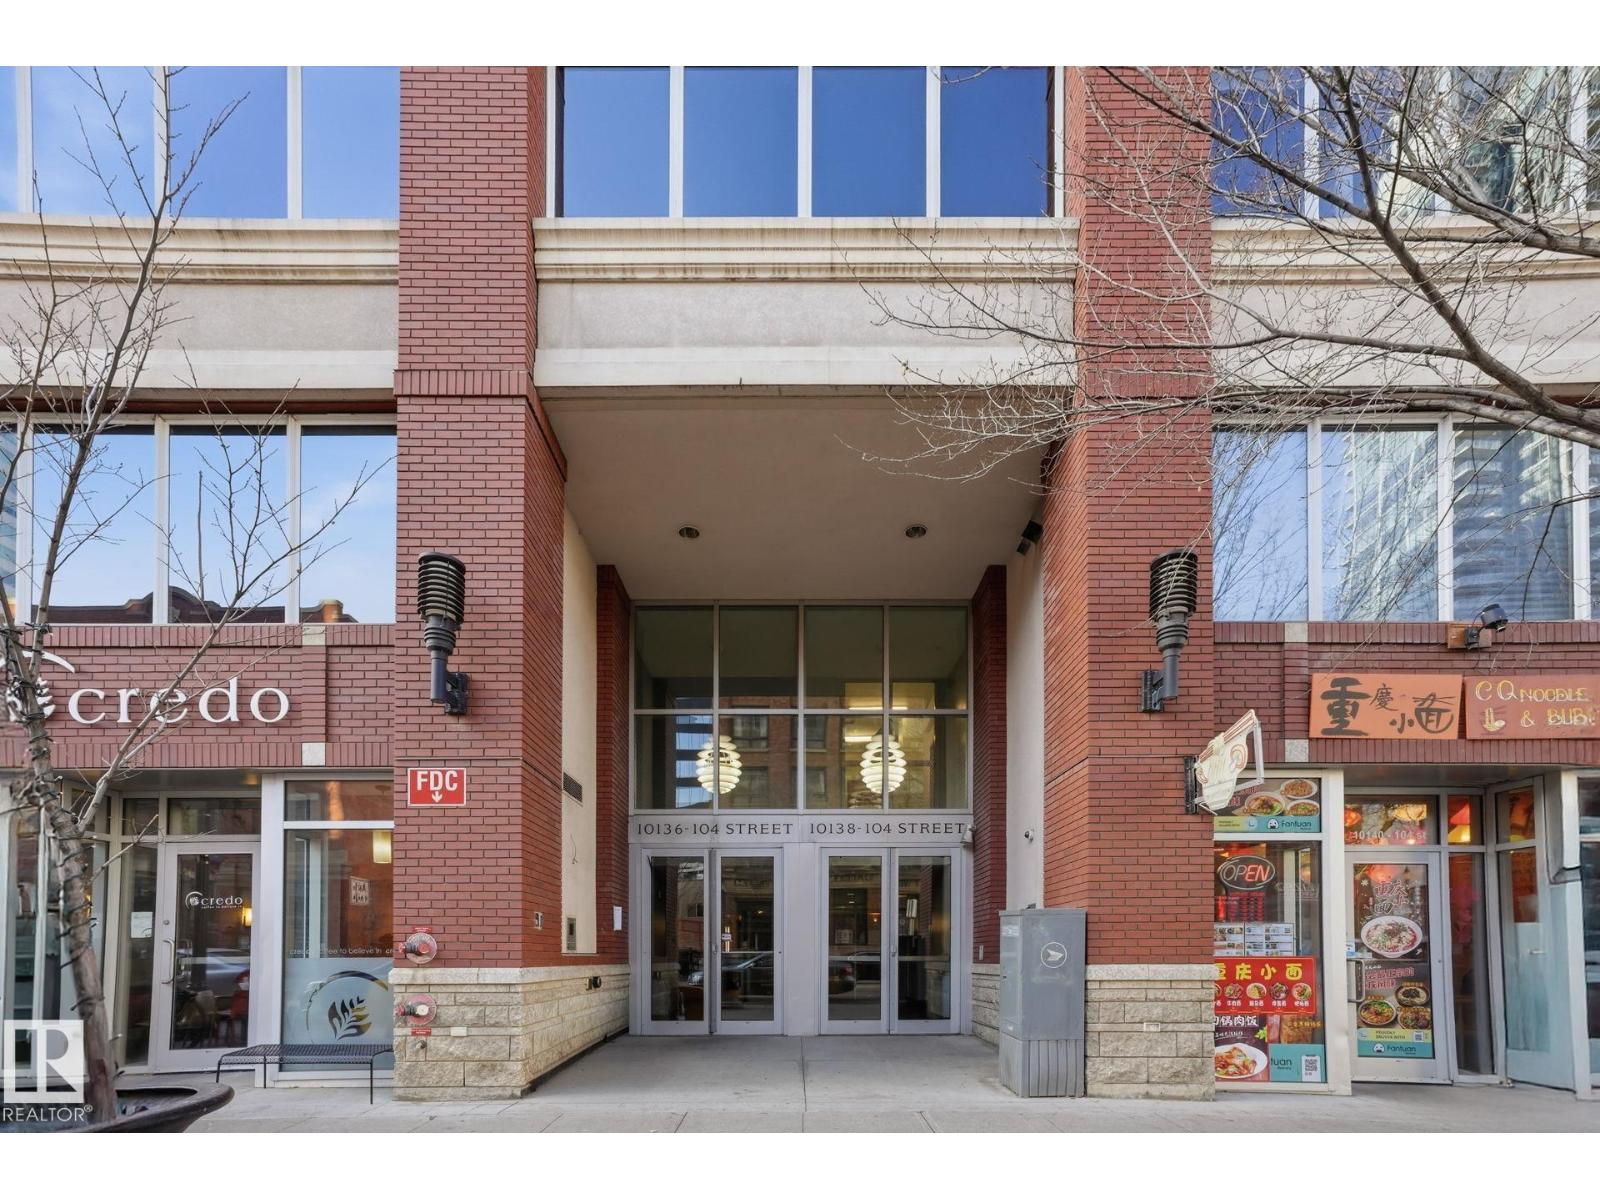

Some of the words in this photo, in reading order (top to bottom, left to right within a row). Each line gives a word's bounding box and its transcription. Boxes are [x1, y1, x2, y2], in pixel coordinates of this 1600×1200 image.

[67, 677, 290, 724] credo
[1520, 687, 1589, 702] NOODLE
[1520, 710, 1535, 728] &
[416, 770, 458, 791] FDC
[637, 823, 719, 835] 10136-104
[726, 823, 793, 835] STREET
[810, 823, 892, 834] 10138-104
[898, 823, 965, 834] STREET
[1281, 820, 1311, 829] Fantuan
[1223, 865, 1270, 881] OPEN
[201, 896, 243, 905] credo
